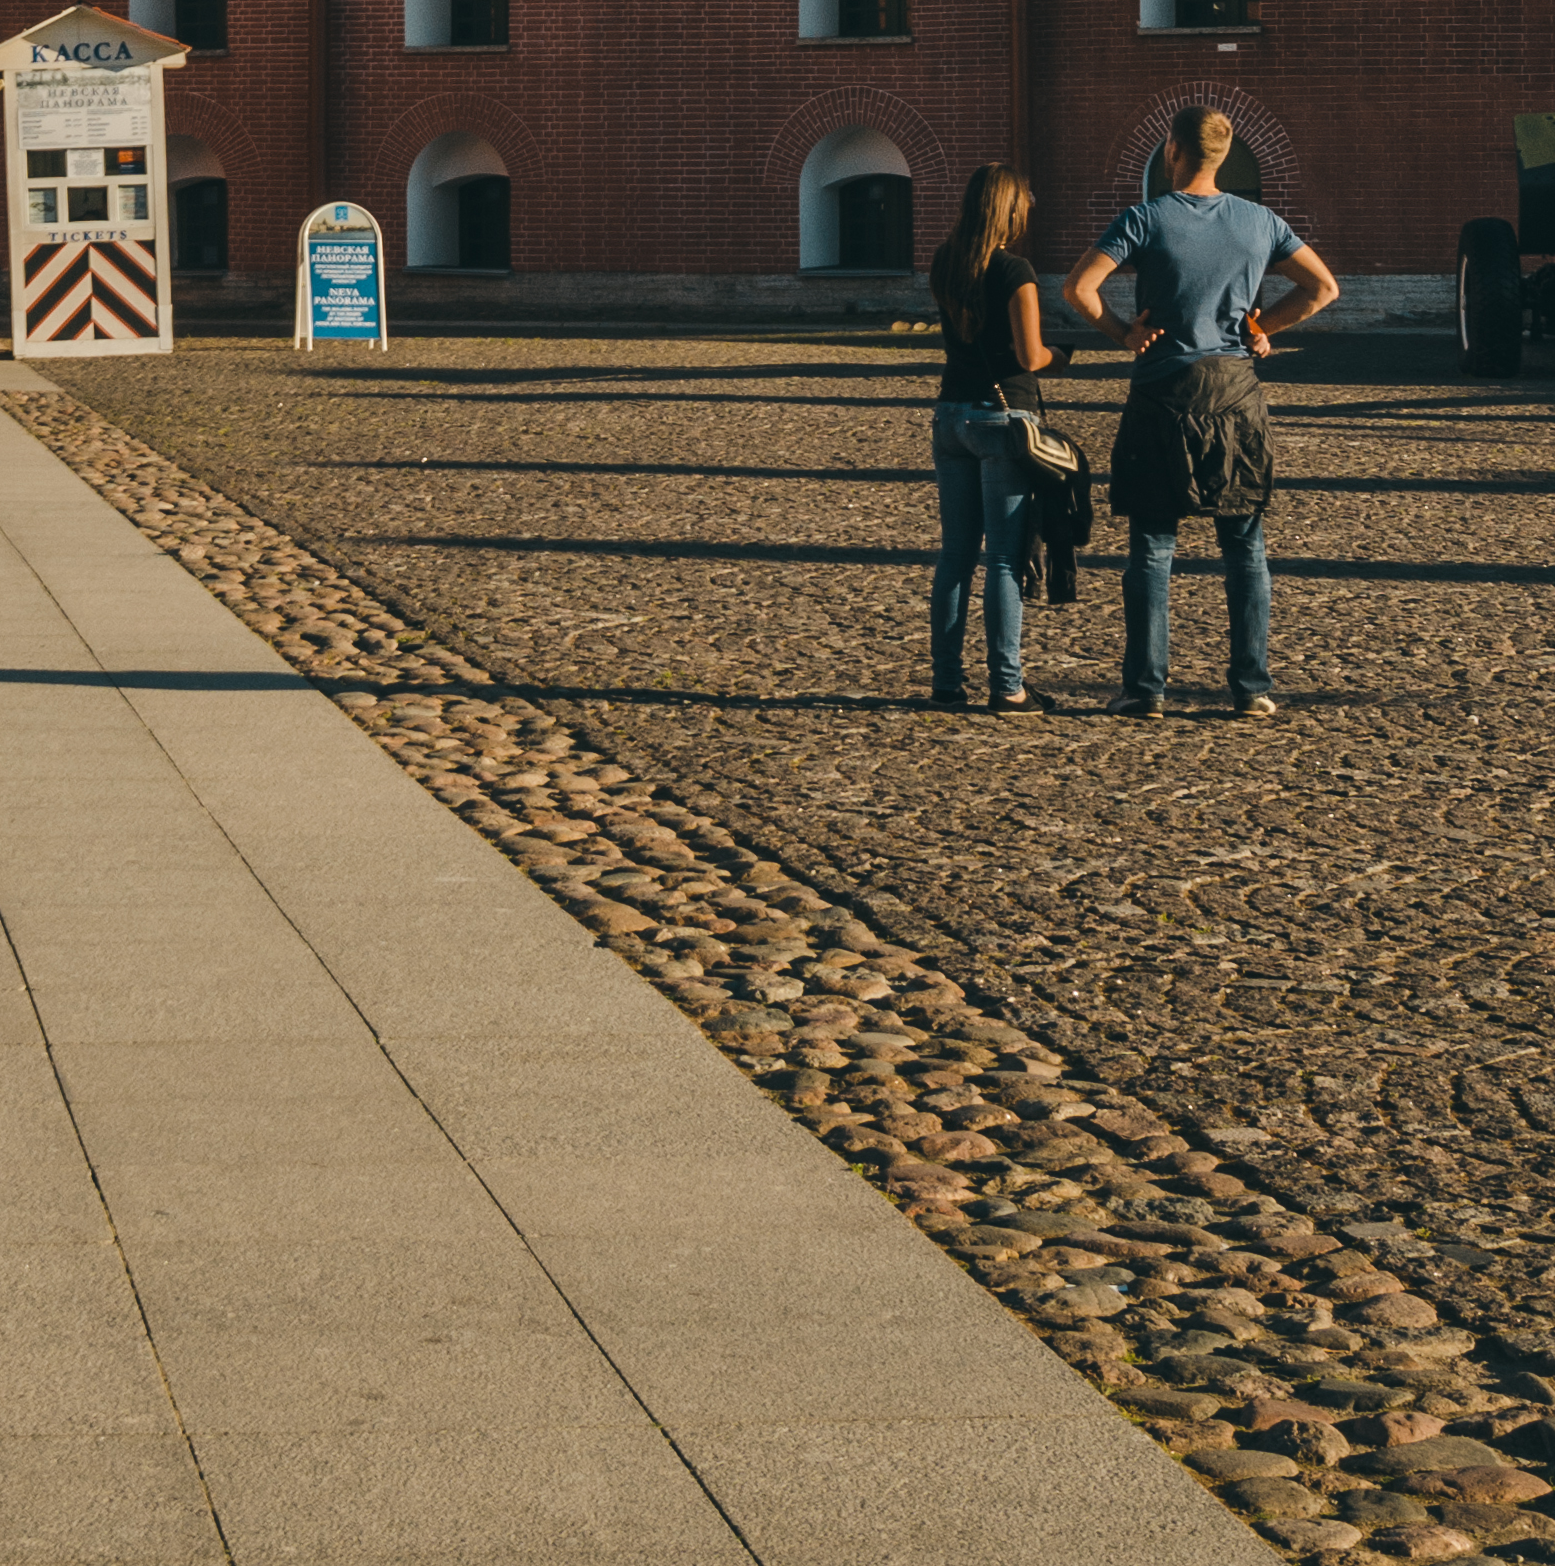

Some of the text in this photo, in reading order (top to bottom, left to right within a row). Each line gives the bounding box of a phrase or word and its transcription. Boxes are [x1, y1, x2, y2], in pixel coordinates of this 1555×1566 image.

[31, 41, 133, 63] КАССА
[47, 86, 120, 97] НЕВСКАЯ
[39, 97, 129, 108] ПАНОРАМА
[48, 230, 127, 242] TICKETS
[316, 246, 369, 254] НЕВСКАЯ
[311, 254, 375, 263] ПАНОРАМА
[328, 288, 360, 296] NEVA
[313, 296, 375, 305] PANORAMA
